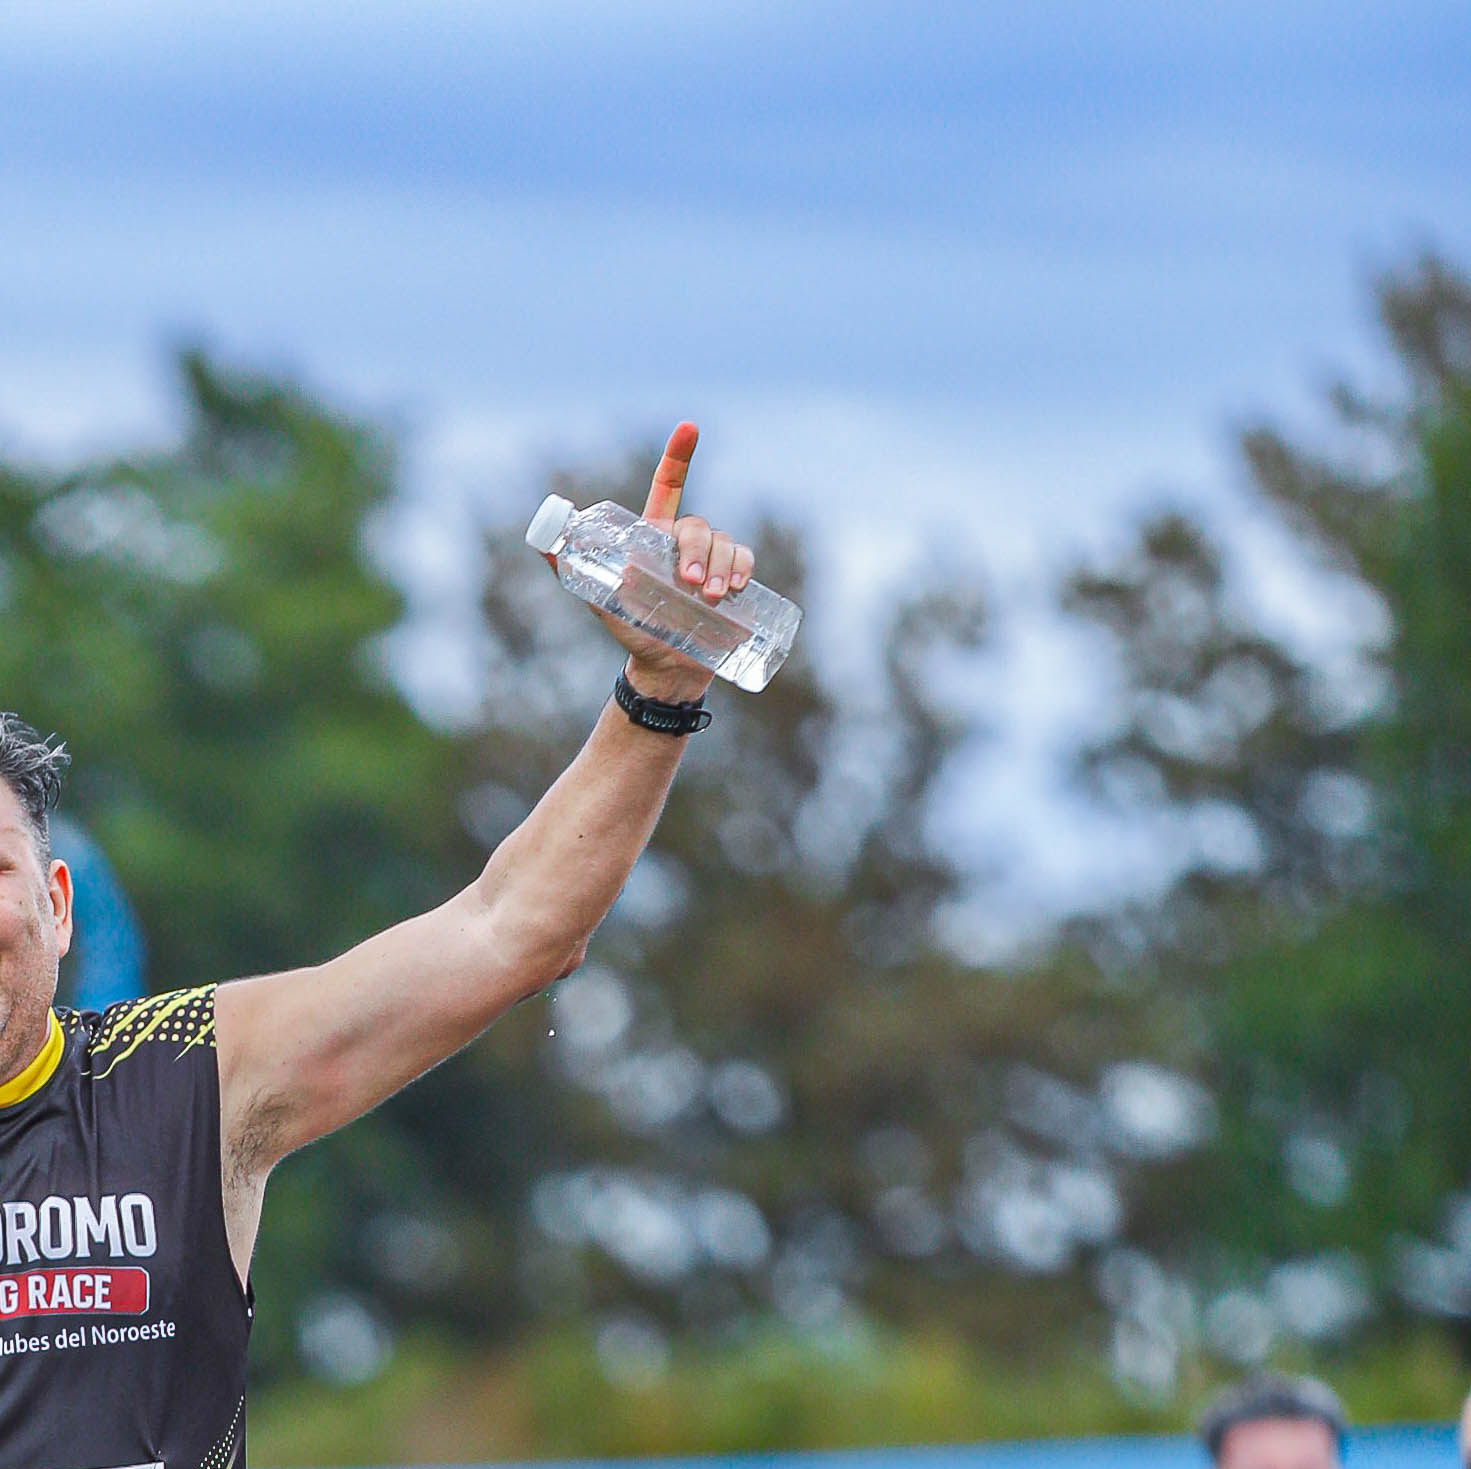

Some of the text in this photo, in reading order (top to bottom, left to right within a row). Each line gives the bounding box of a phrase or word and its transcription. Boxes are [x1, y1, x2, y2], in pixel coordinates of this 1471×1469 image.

[28, 1272, 112, 1310] RACE
[55, 1327, 86, 1350] del
[92, 1318, 176, 1346] Noroeste
